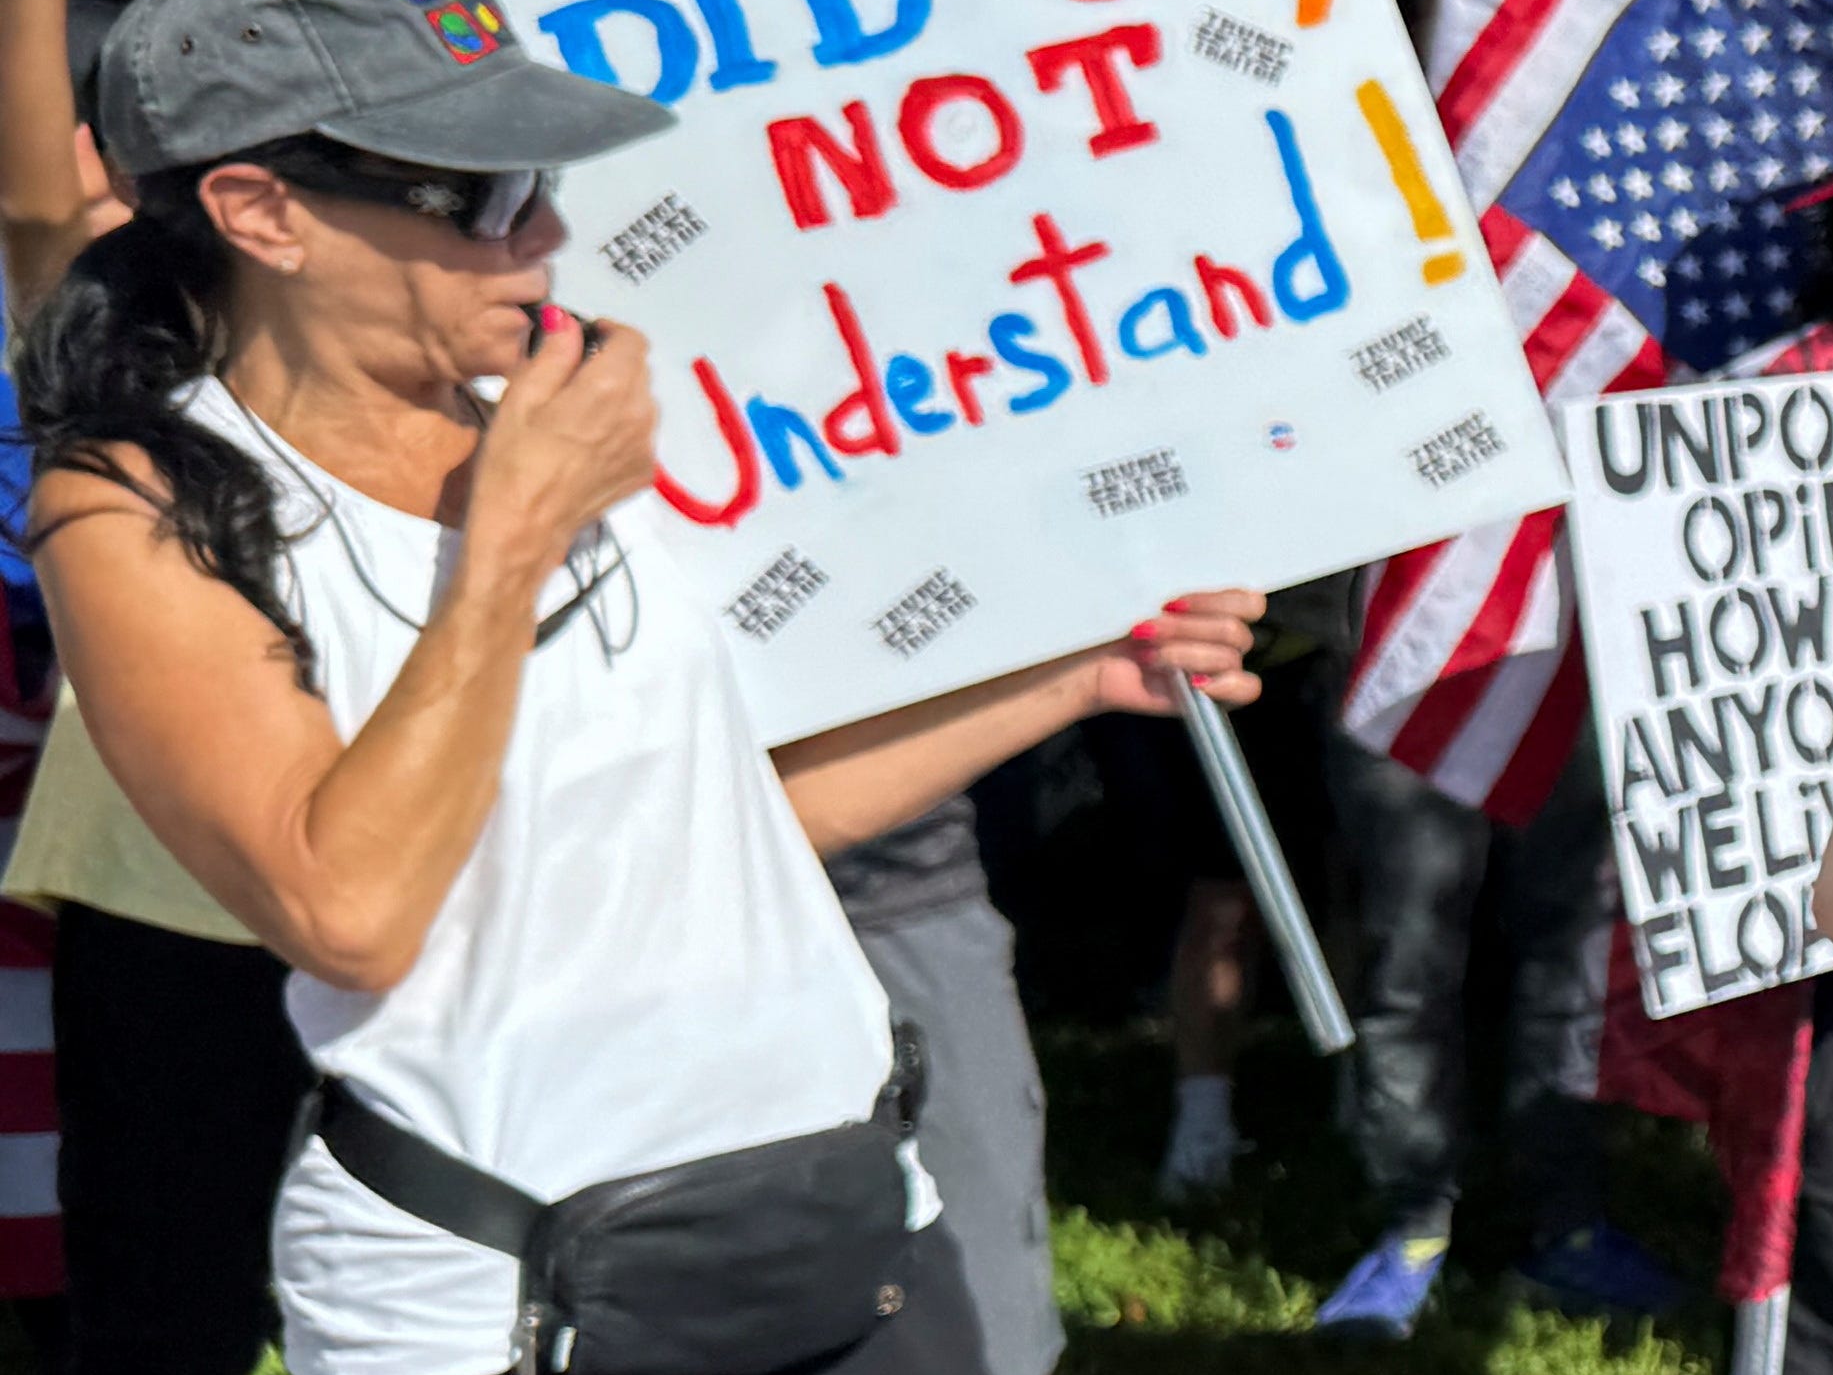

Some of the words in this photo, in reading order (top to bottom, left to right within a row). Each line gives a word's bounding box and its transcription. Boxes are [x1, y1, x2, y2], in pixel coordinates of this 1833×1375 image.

[764, 23, 1165, 233] NOT
[654, 108, 1351, 531] Understand
[1640, 575, 1831, 699] HOW
